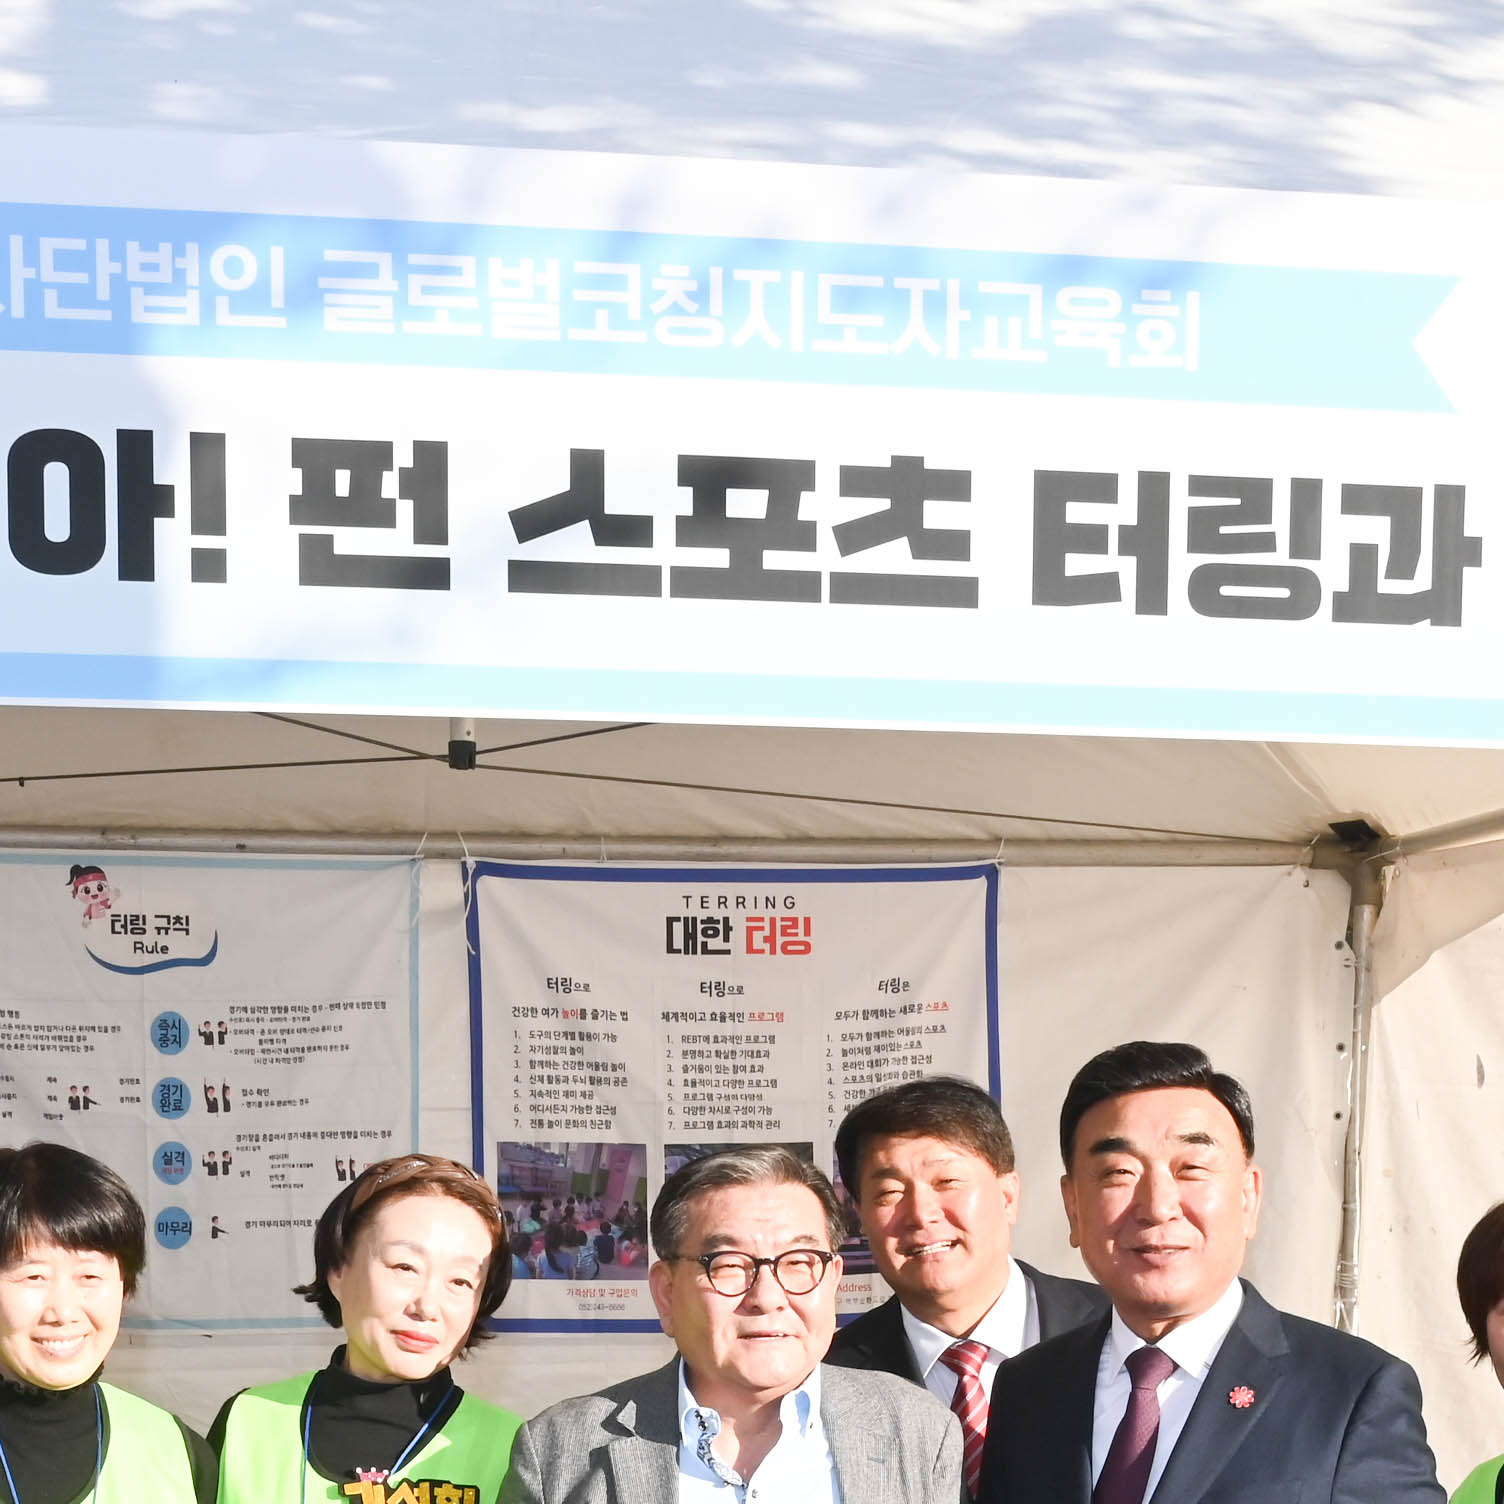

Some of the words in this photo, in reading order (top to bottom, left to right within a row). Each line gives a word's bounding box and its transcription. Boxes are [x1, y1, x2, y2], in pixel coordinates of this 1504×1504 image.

[315, 250, 1201, 371] 글로벌코칭지도자교육회
[288, 435, 451, 590] 펀
[507, 447, 979, 609] 스포츠
[1032, 469, 1483, 628] 터링과
[682, 896, 796, 909] TERRING
[111, 914, 147, 935] 터링
[154, 915, 189, 936] 규칙
[666, 916, 733, 955] 대한
[746, 916, 811, 955] 터링
[133, 941, 169, 954] Rule
[546, 977, 591, 994] 터링으로
[700, 981, 744, 997] 터링으로
[878, 977, 910, 994] 터링은
[512, 1006, 538, 1018] 건강한
[541, 1008, 559, 1019] 여가
[561, 1009, 588, 1021] 놀이를
[591, 1010, 617, 1021] 즐기는
[620, 1011, 628, 1021] 법
[661, 1011, 707, 1023] 체계적이고
[709, 1012, 745, 1023] 효율적인
[747, 1012, 784, 1022] 프로그램
[834, 1010, 859, 1021] 모두가
[862, 1008, 896, 1020] 함께하는
[899, 1003, 923, 1015] 새로운
[158, 1020, 182, 1033] 즉시
[158, 1033, 182, 1048] 중지
[159, 1084, 183, 1098] 경기
[159, 1098, 184, 1112] 완료
[162, 1151, 184, 1166] 실격
[157, 1220, 192, 1236] 마무리
[837, 1283, 872, 1292] Address
